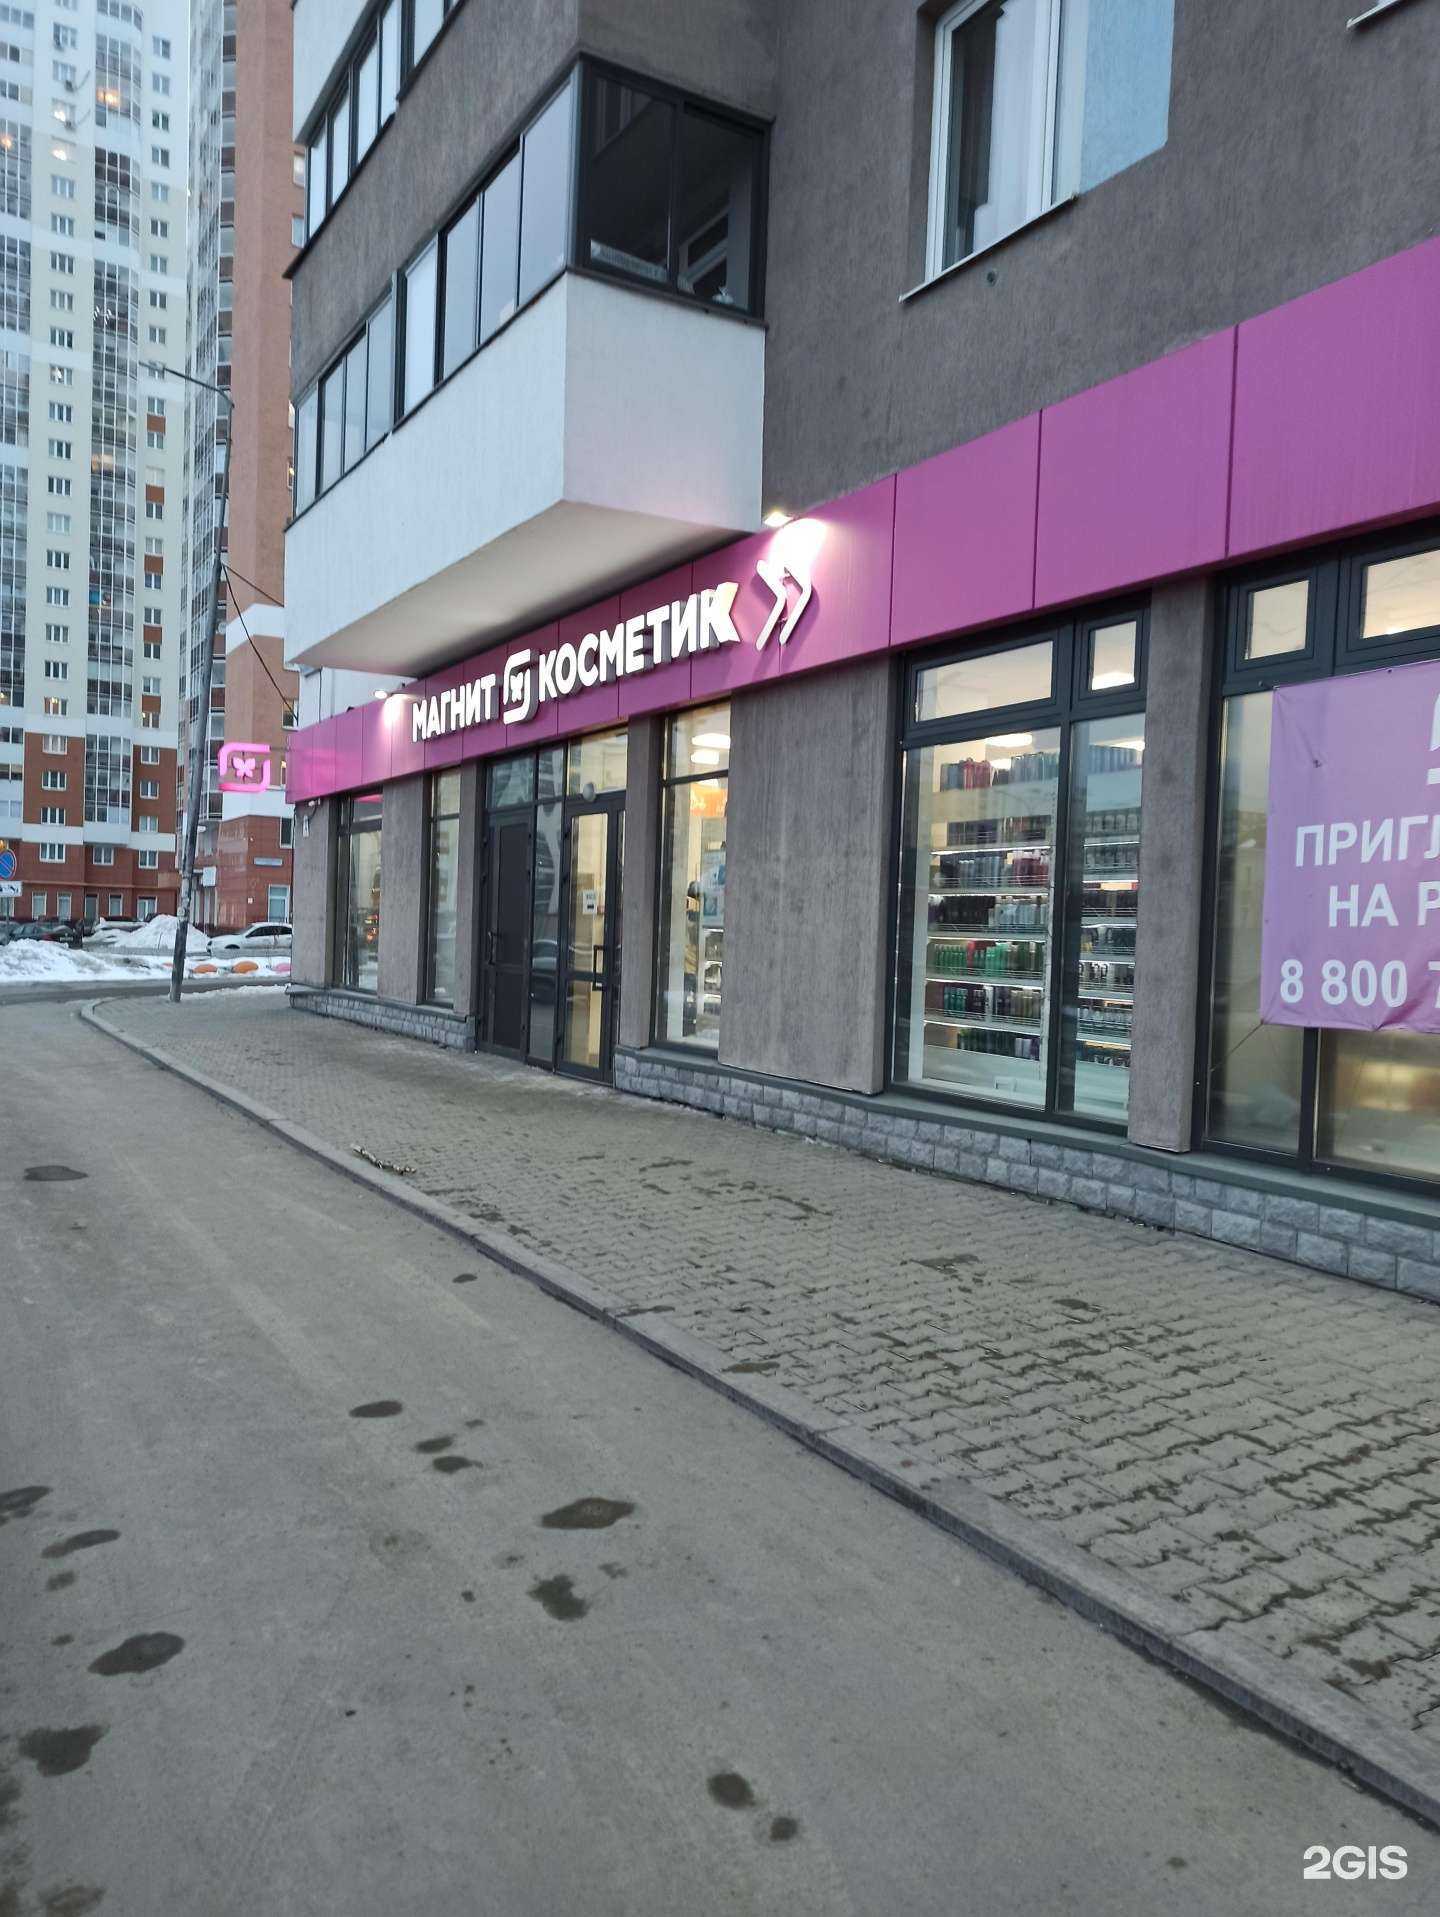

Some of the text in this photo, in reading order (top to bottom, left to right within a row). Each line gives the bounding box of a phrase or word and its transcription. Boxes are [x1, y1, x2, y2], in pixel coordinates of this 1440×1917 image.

[412, 582, 741, 743] МАГНИТ КОСМЕТИК
[1328, 883, 1400, 928] НА
[1280, 959, 1304, 1004] 8
[1320, 959, 1408, 1008] 800
